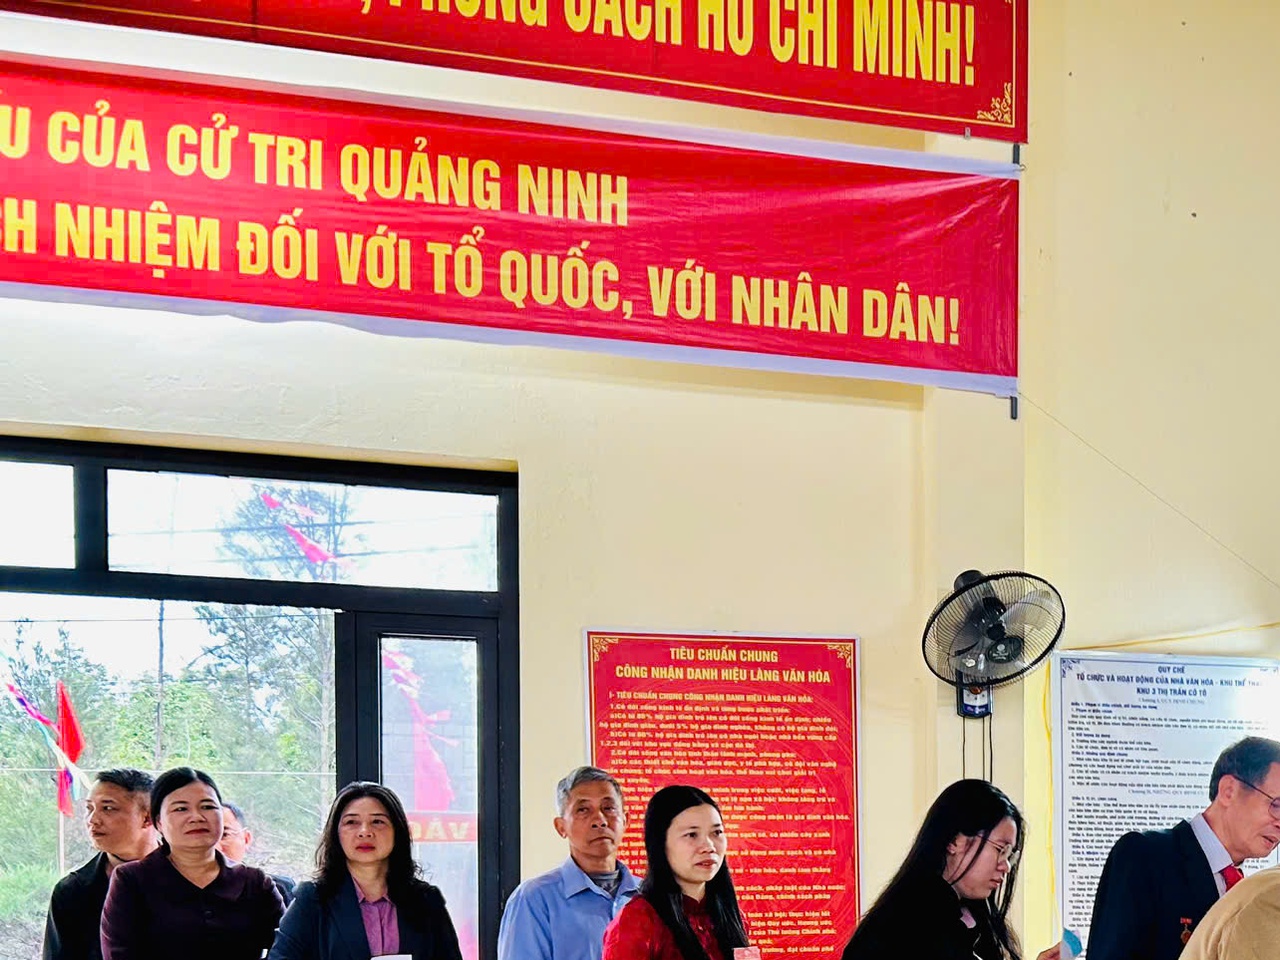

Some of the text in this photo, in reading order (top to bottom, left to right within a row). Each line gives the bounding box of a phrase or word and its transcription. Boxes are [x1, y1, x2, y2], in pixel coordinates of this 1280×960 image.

[853, 0, 974, 86] MINH!
[0, 100, 628, 227] U CỦA CỬ TRI QUẢNG NINH
[0, 197, 960, 345] H NHIỆM ĐỐI VỚI TỔ QUỐC, VỚI NHÂN DÂN!
[616, 663, 648, 678] CÔNG
[651, 666, 684, 680] NHẬN
[687, 668, 719, 680] DANH
[721, 667, 747, 683] HIỆU
[750, 668, 780, 682] LÀNG
[782, 669, 806, 682] VĂN
[670, 645, 778, 662] TIÊU CHUẨN CHUNG
